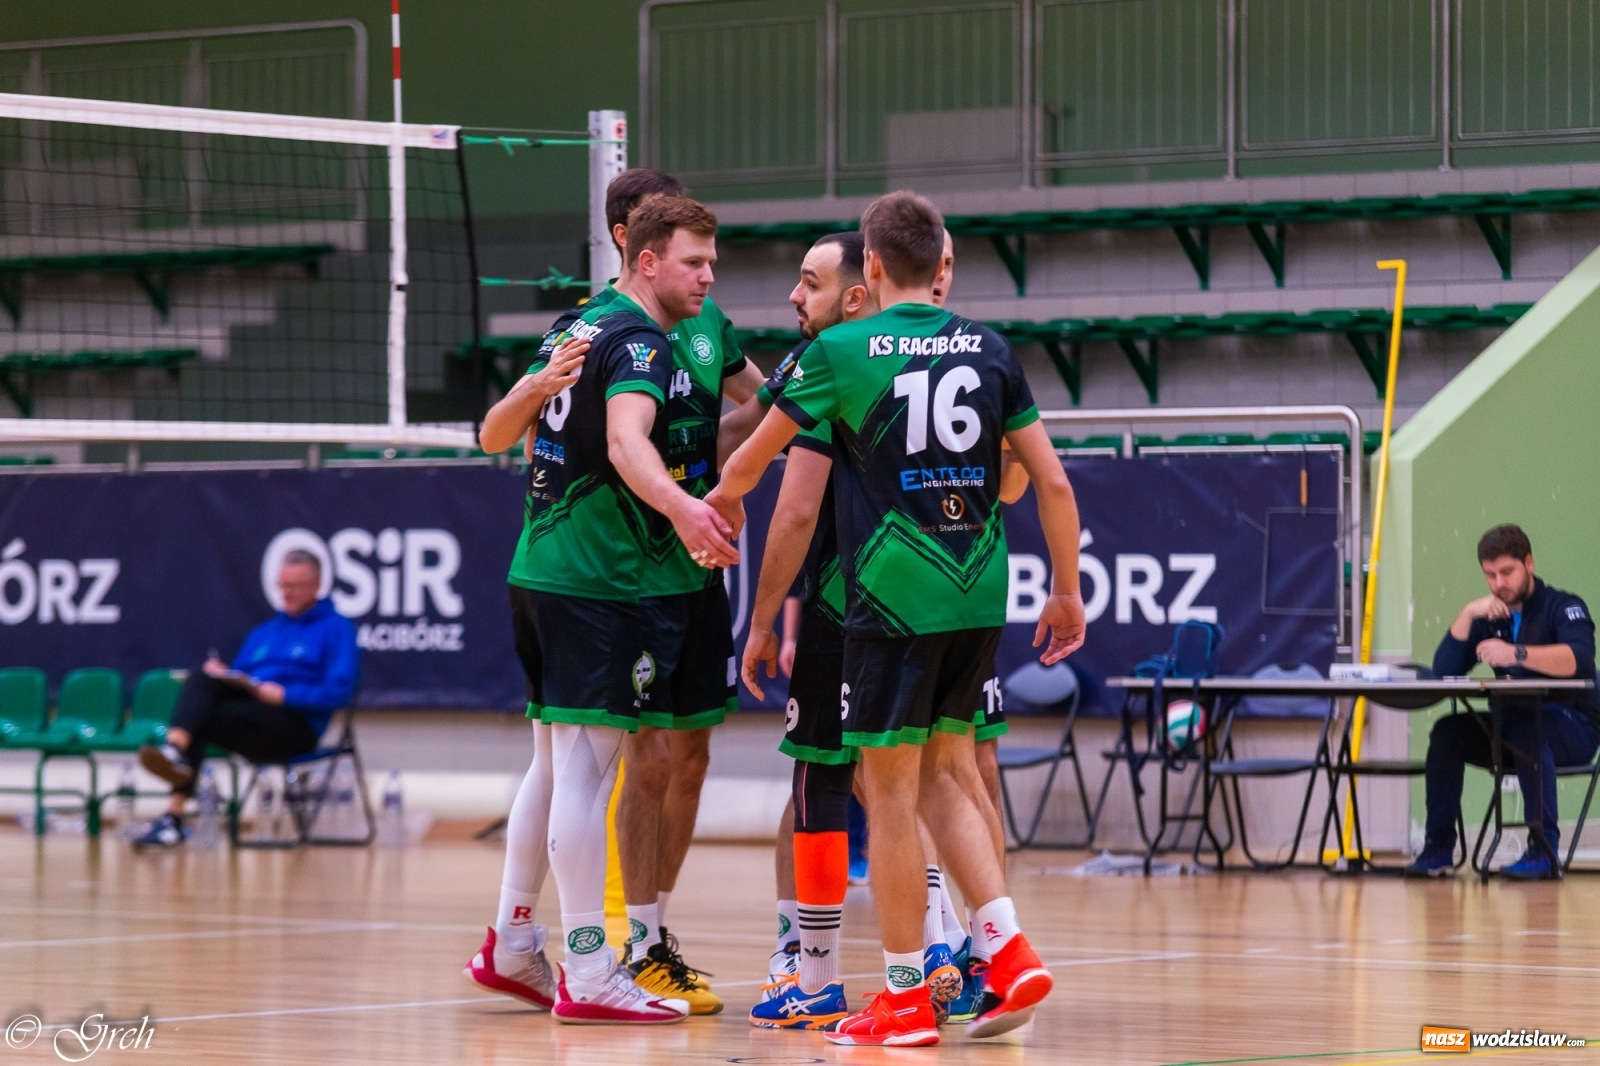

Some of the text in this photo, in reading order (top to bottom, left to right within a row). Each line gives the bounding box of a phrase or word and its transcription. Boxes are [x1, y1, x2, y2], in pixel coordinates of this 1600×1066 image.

[868, 327, 982, 357] KS RACIBÓRZ
[633, 361, 651, 369] PCS
[894, 365, 982, 455] 16
[900, 467, 985, 490] ENTECO
[939, 524, 964, 532] Studio
[964, 522, 986, 531] Ener
[512, 905, 532, 920] R
